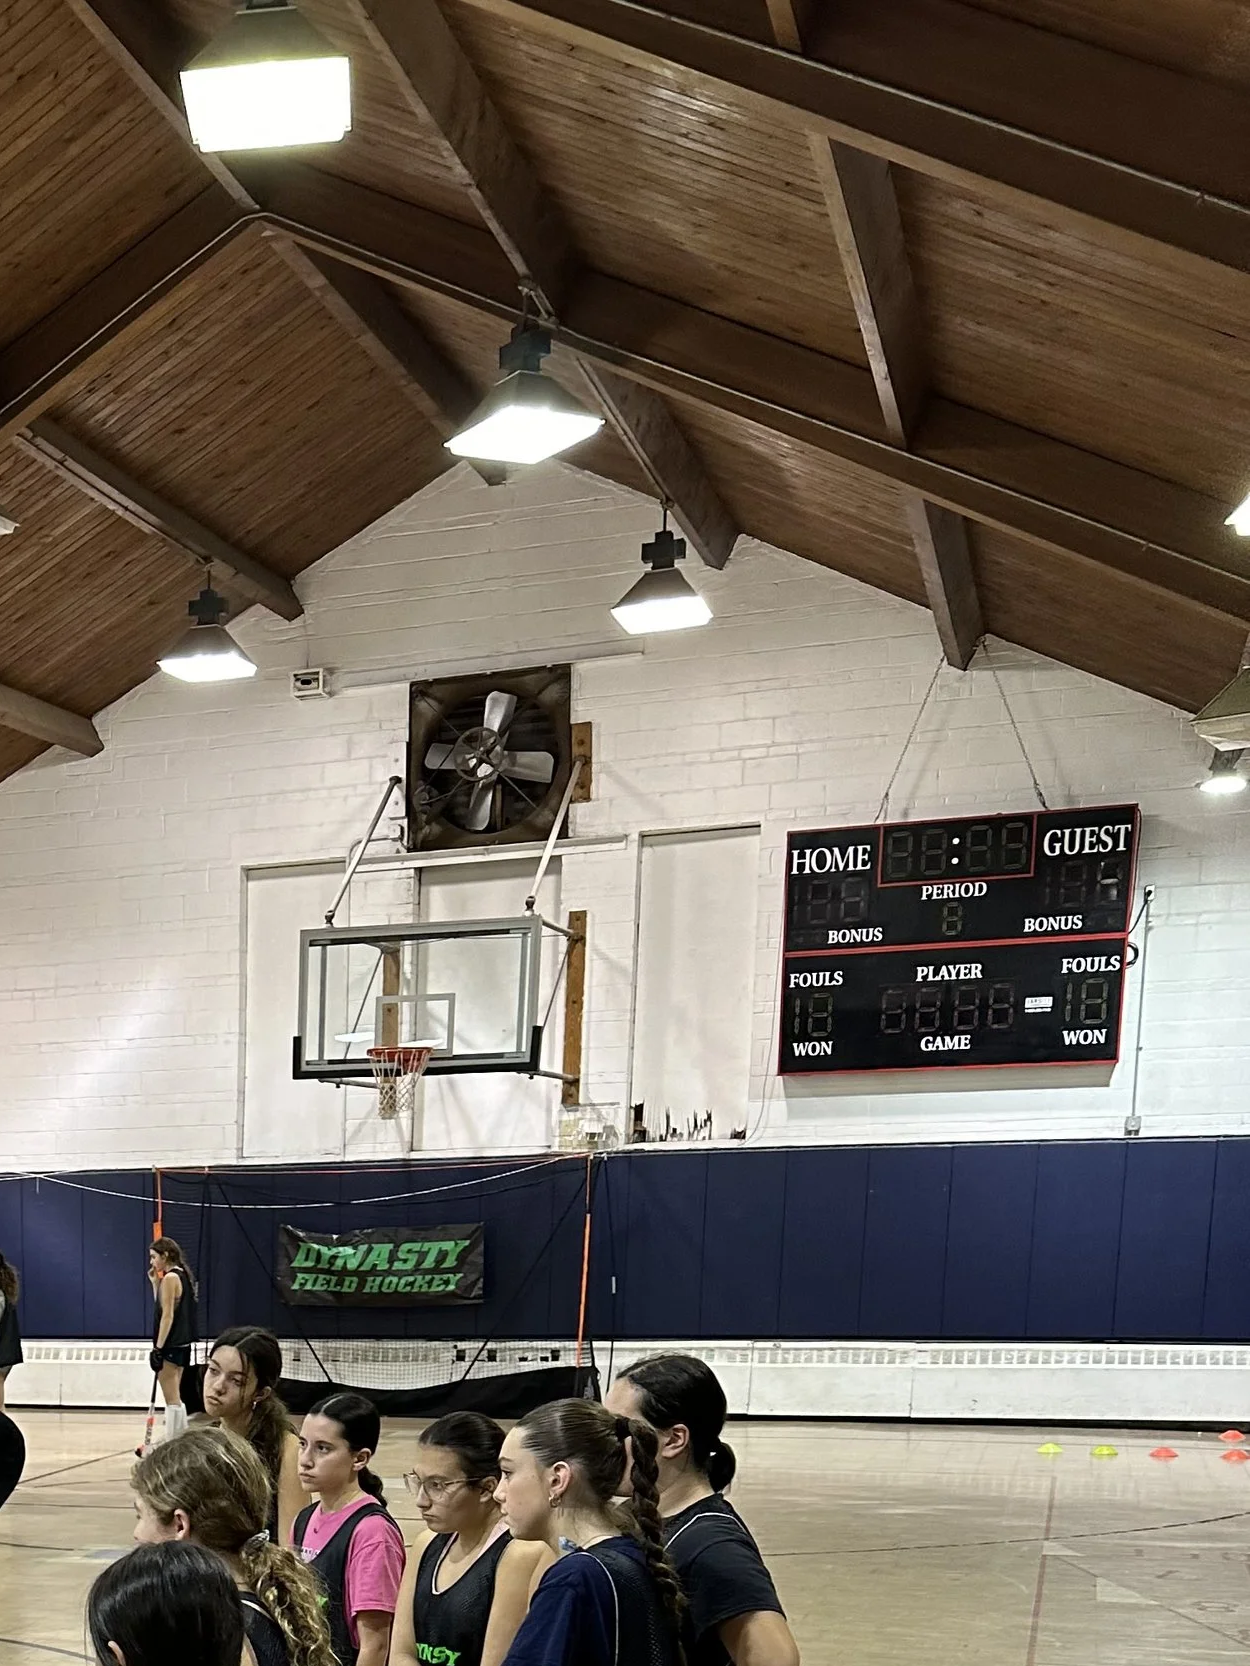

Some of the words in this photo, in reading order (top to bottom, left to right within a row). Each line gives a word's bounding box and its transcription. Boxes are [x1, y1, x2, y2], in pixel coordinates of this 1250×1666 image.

[1043, 824, 1132, 857] GUEST
[790, 845, 872, 875] HOME
[920, 882, 988, 900] PERIOD
[1023, 915, 1083, 932] BONUS
[827, 927, 883, 944] BONUS
[915, 963, 983, 982] PLAYER
[1060, 955, 1121, 974] FOULS
[789, 971, 844, 988] FOULS
[920, 1035, 971, 1051] GAME
[1062, 1028, 1107, 1045] WON
[792, 1041, 833, 1057] WON
[290, 1239, 471, 1271] DYNASTY
[290, 1273, 358, 1293] FIELD
[362, 1272, 464, 1293] HOCKEY
